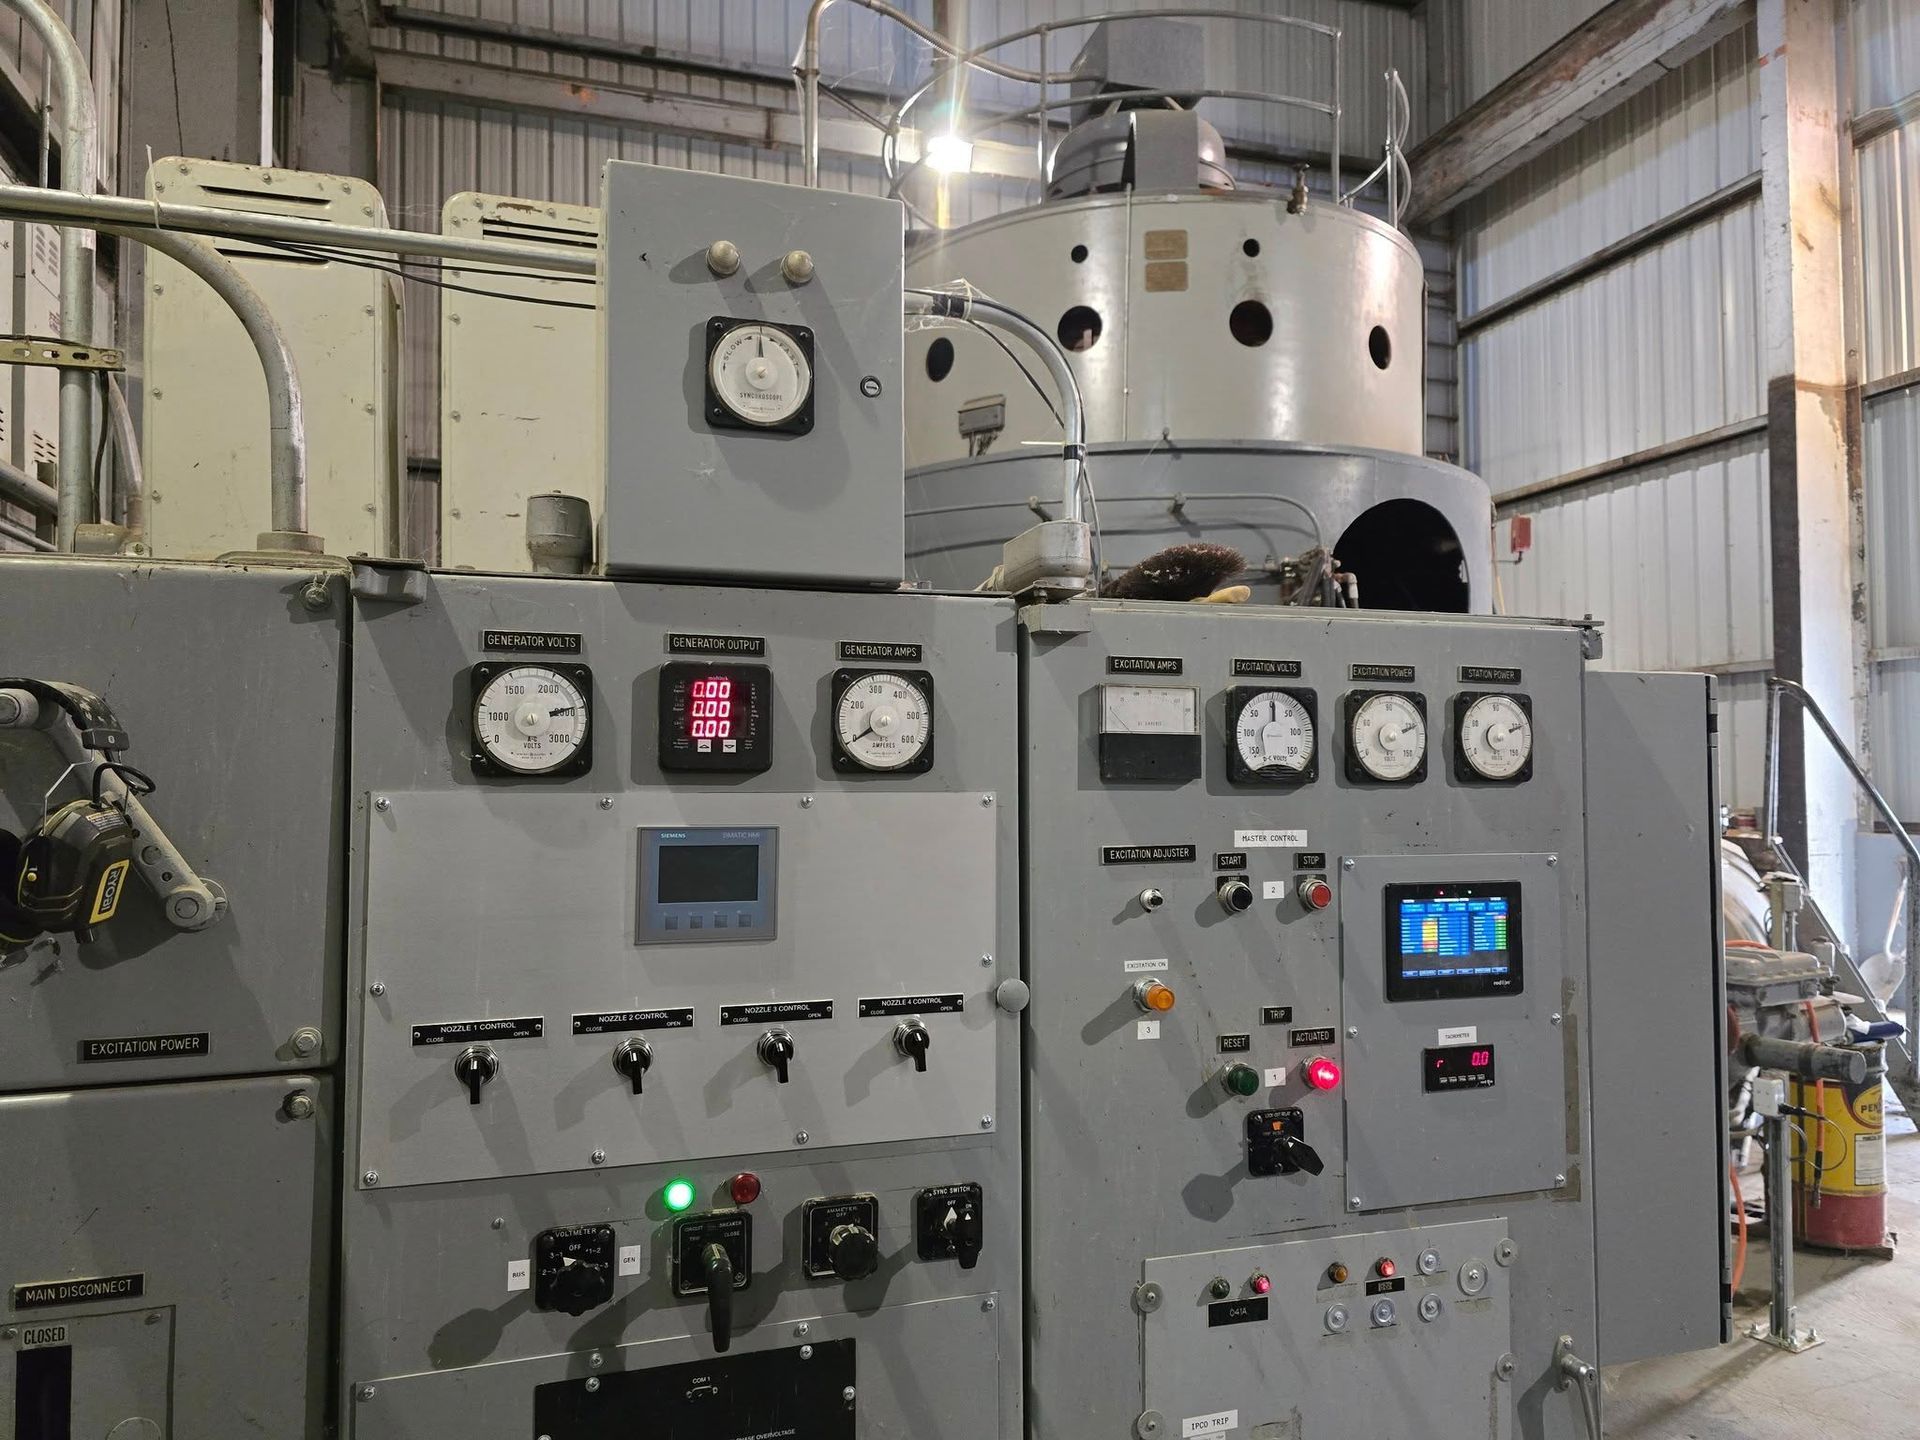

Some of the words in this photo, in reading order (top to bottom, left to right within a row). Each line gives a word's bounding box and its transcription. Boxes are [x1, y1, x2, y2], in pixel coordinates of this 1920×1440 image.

[724, 339, 743, 361] SLOW
[778, 342, 800, 367] FAST
[487, 634, 544, 648] GENERATOR
[547, 637, 577, 648] VOLTS
[673, 637, 726, 650] GENERATOR
[727, 640, 761, 651] OUTPUT
[845, 644, 892, 656] GENERATOR
[894, 647, 917, 657] AMPS
[1114, 659, 1156, 670] EXCITATION
[1157, 661, 1177, 670] AMPS
[1236, 662, 1275, 672] EXCITATION
[1277, 664, 1298, 673] VOLTS
[1353, 667, 1390, 677] EXCITATION
[1391, 669, 1413, 678] POWER
[1468, 670, 1493, 679] STATION
[1494, 671, 1515, 680] POWER
[505, 685, 525, 695] 1500
[538, 684, 559, 694] 2000
[869, 685, 882, 694] 300
[893, 690, 907, 699] 400
[850, 700, 864, 710] 200
[488, 711, 509, 721] 1000
[906, 711, 920, 720] 500
[1250, 709, 1259, 718] 50
[1284, 709, 1293, 718] 50
[1243, 728, 1255, 737] 100
[1290, 728, 1301, 736] 100
[494, 734, 500, 743] 0
[549, 734, 570, 743] 3000
[901, 734, 915, 744] 600
[1249, 746, 1260, 755] 150
[1287, 746, 1298, 755] 150
[1403, 750, 1413, 758] 150
[1270, 834, 1299, 842] CONTROL
[1110, 850, 1151, 860] EXCITATION
[1152, 848, 1190, 859] ADJUSTER
[1220, 855, 1242, 866] START
[1303, 856, 1320, 866] STOP
[101, 867, 122, 912] RYOBI
[1271, 886, 1276, 894] 2
[882, 999, 906, 1007] NOZZLE
[913, 997, 942, 1005] CONTROL
[745, 1007, 771, 1015] NOZZLE
[778, 1004, 810, 1012] CONTROL
[598, 1015, 626, 1023] NOZZLE
[635, 1012, 669, 1020] CONTROL
[1270, 1010, 1285, 1020] TRIP
[440, 1025, 471, 1033] NOZZLE
[479, 1021, 517, 1030] CONTROL
[1296, 1031, 1330, 1043] ACTUATED
[91, 1040, 157, 1055] EXCITATION
[160, 1037, 200, 1051] POWER
[1224, 1038, 1246, 1048] RESET
[1472, 1051, 1489, 1066] 0.0
[950, 1186, 971, 1194] SWITCH
[555, 1227, 597, 1238] VOLTMETER
[512, 1271, 525, 1279] BUS
[25, 1289, 56, 1302] MAIN
[59, 1279, 132, 1299] DISCONNECT
[24, 1326, 65, 1345] CLOSED
[1212, 1417, 1229, 1426] TRIP
[756, 1429, 795, 1440] OVERVOLTAGE
